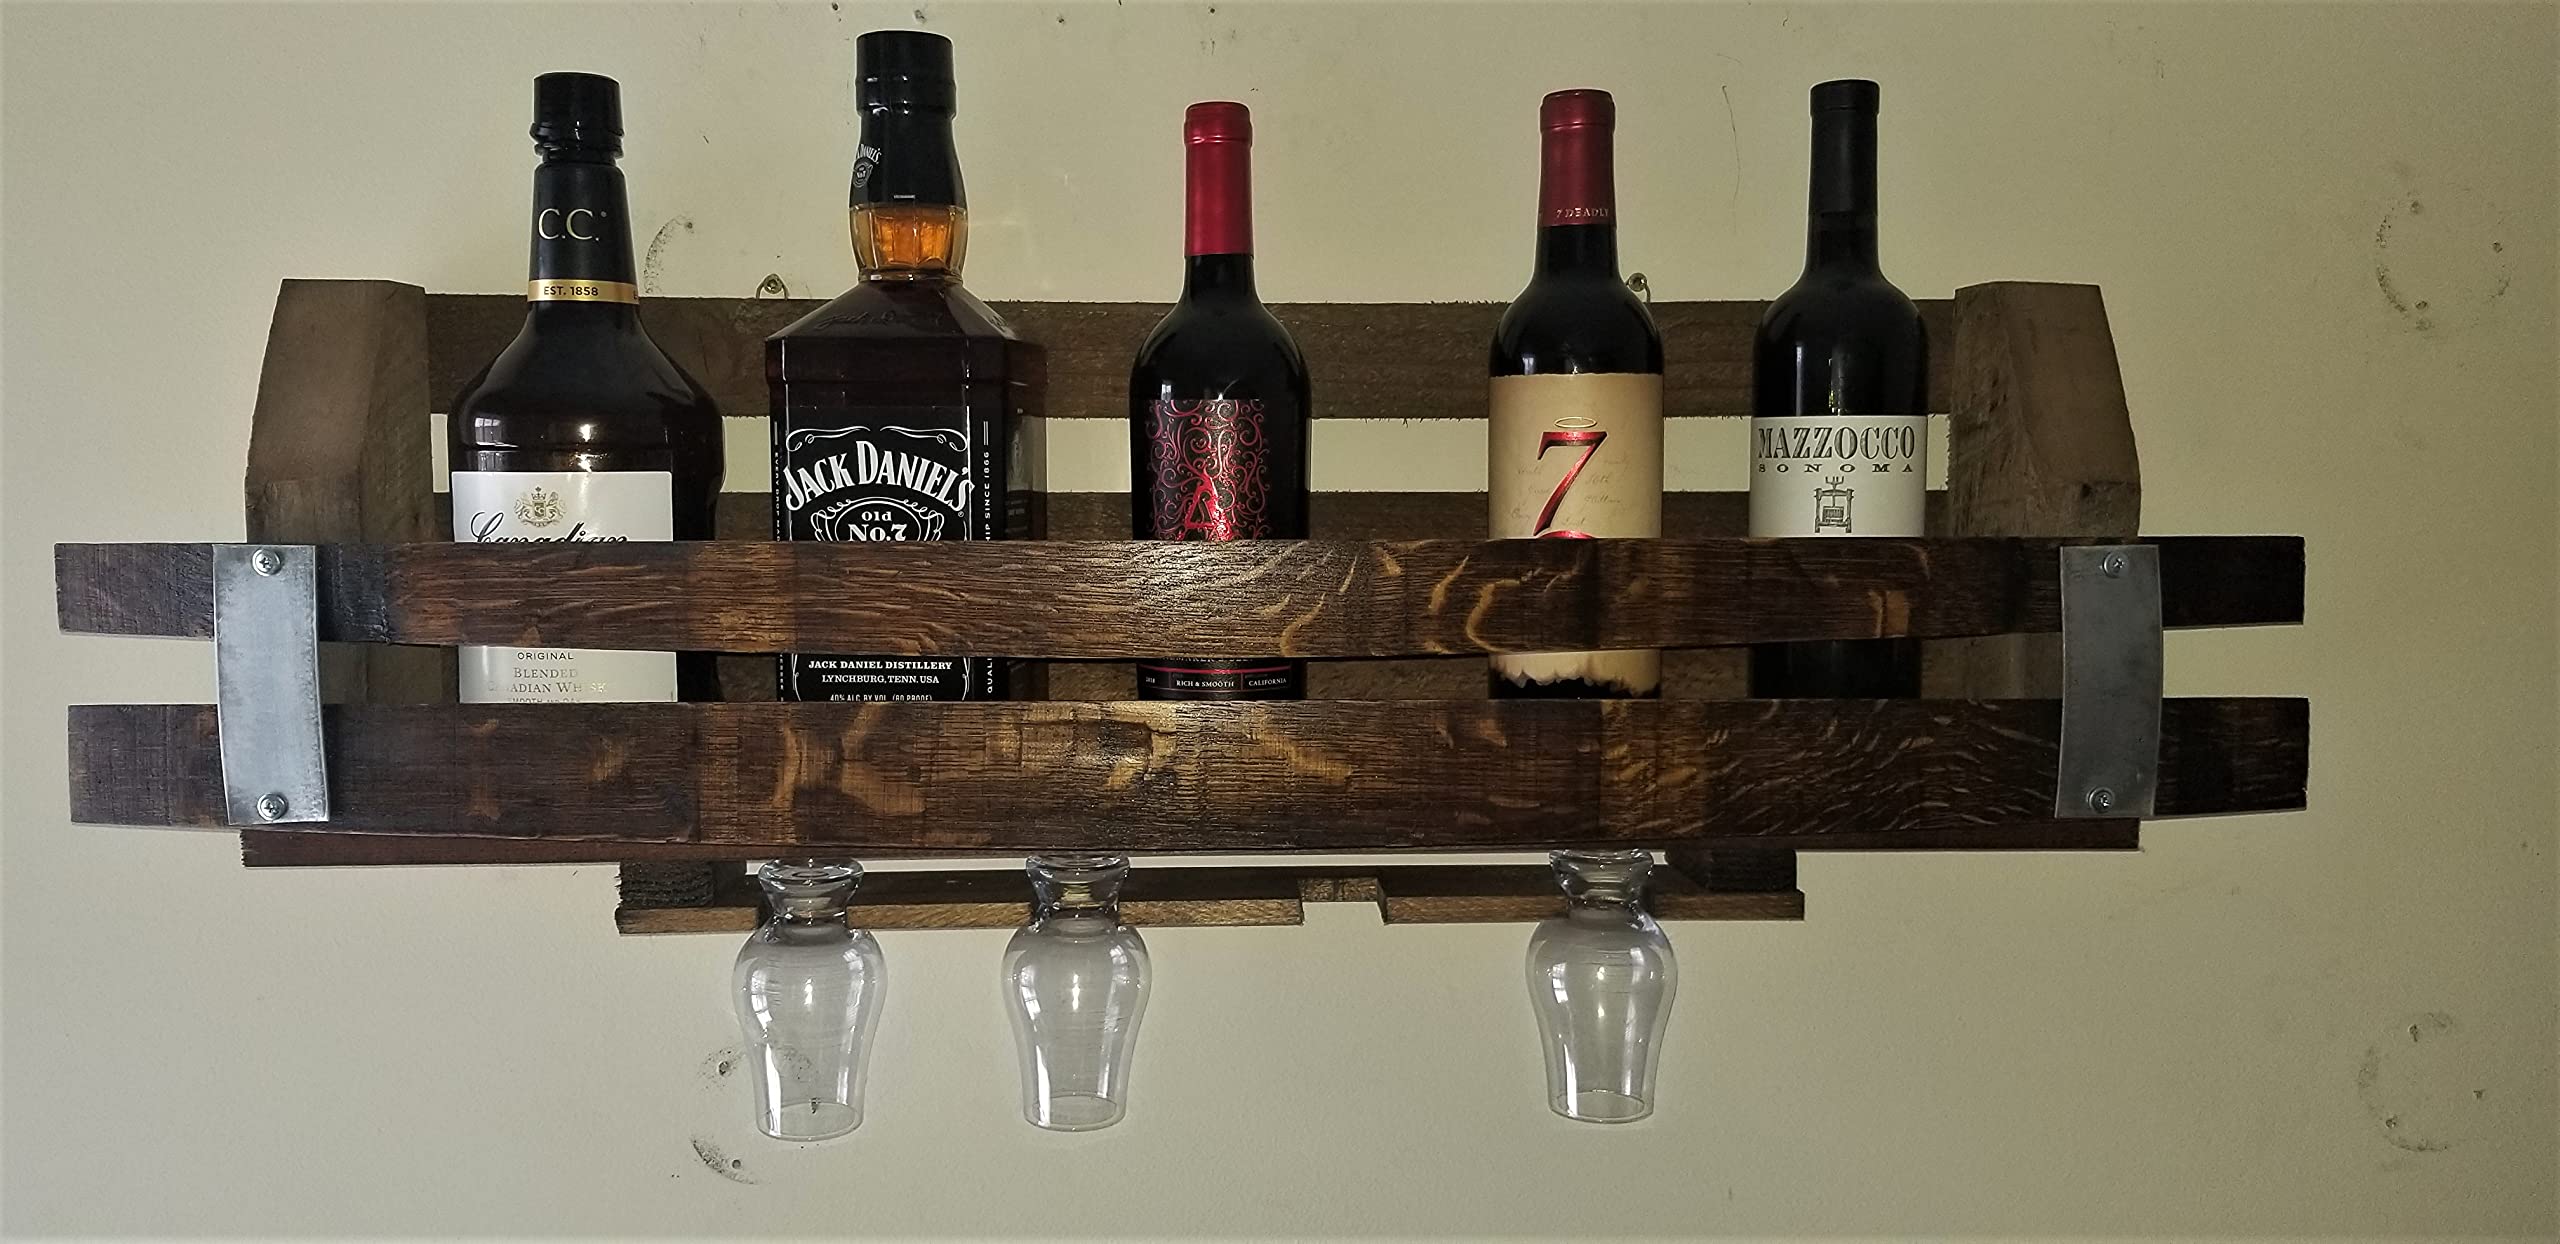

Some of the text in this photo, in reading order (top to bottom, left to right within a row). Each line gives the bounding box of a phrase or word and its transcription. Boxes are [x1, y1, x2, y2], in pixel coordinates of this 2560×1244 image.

[538, 208, 600, 241] C.C.
[543, 286, 599, 296] EST. 1858
[1758, 426, 1915, 460] MAZZOCCO
[1758, 463, 1913, 473] SONOMA
[783, 440, 976, 512] JACK DANIEL'S
[1533, 431, 1608, 537] 7
[861, 511, 892, 522] Old
[517, 652, 574, 660] ORIGINAL
[808, 661, 953, 670] JACK DANIEL DISTILLERY
[822, 675, 940, 684] LYNCHBURG, TENN. USA
[1248, 678, 1287, 687] CALIFORNIA
[487, 681, 552, 693] CADIAN
